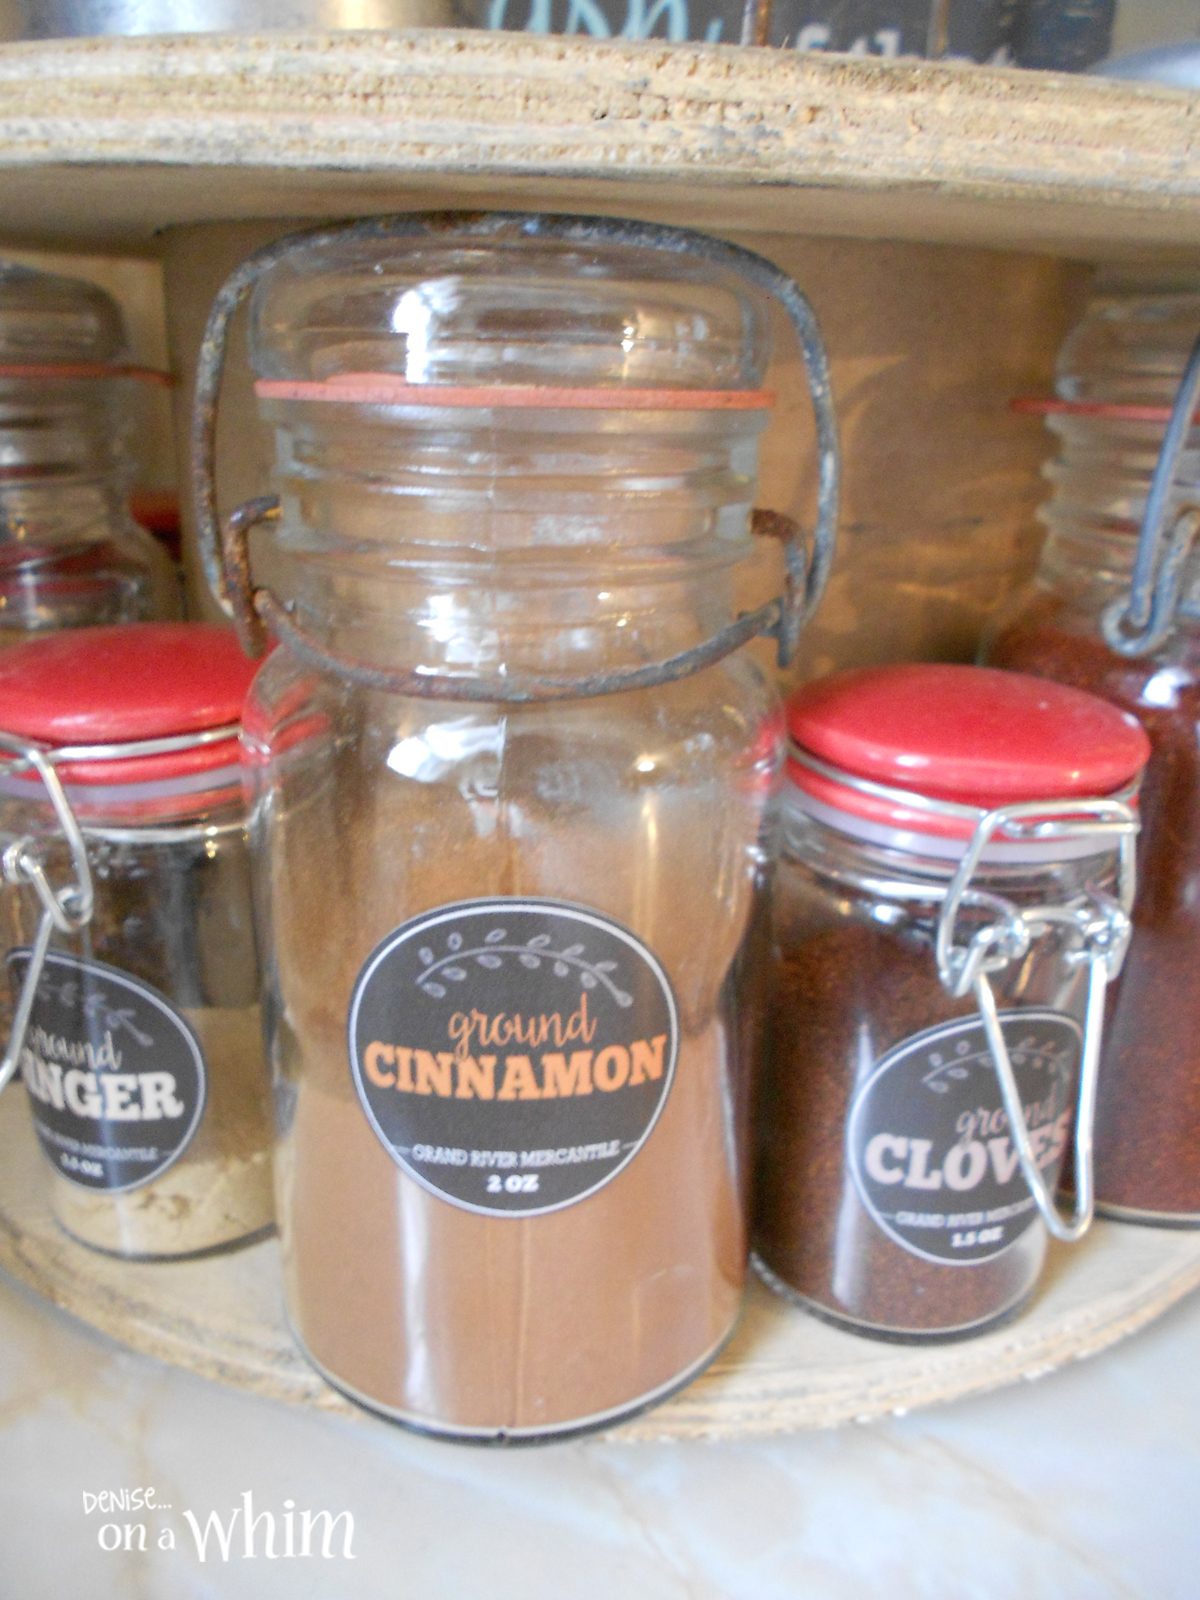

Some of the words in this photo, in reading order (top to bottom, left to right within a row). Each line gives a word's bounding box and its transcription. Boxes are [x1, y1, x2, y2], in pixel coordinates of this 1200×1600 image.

[448, 991, 598, 1062] ground
[363, 1034, 668, 1101] CINNAMON
[411, 1143, 468, 1167] GRAND
[469, 1149, 519, 1169] RIVER
[519, 1139, 621, 1168] MERCANTILE
[486, 1174, 503, 1193] 2
[504, 1173, 540, 1193] OZ
